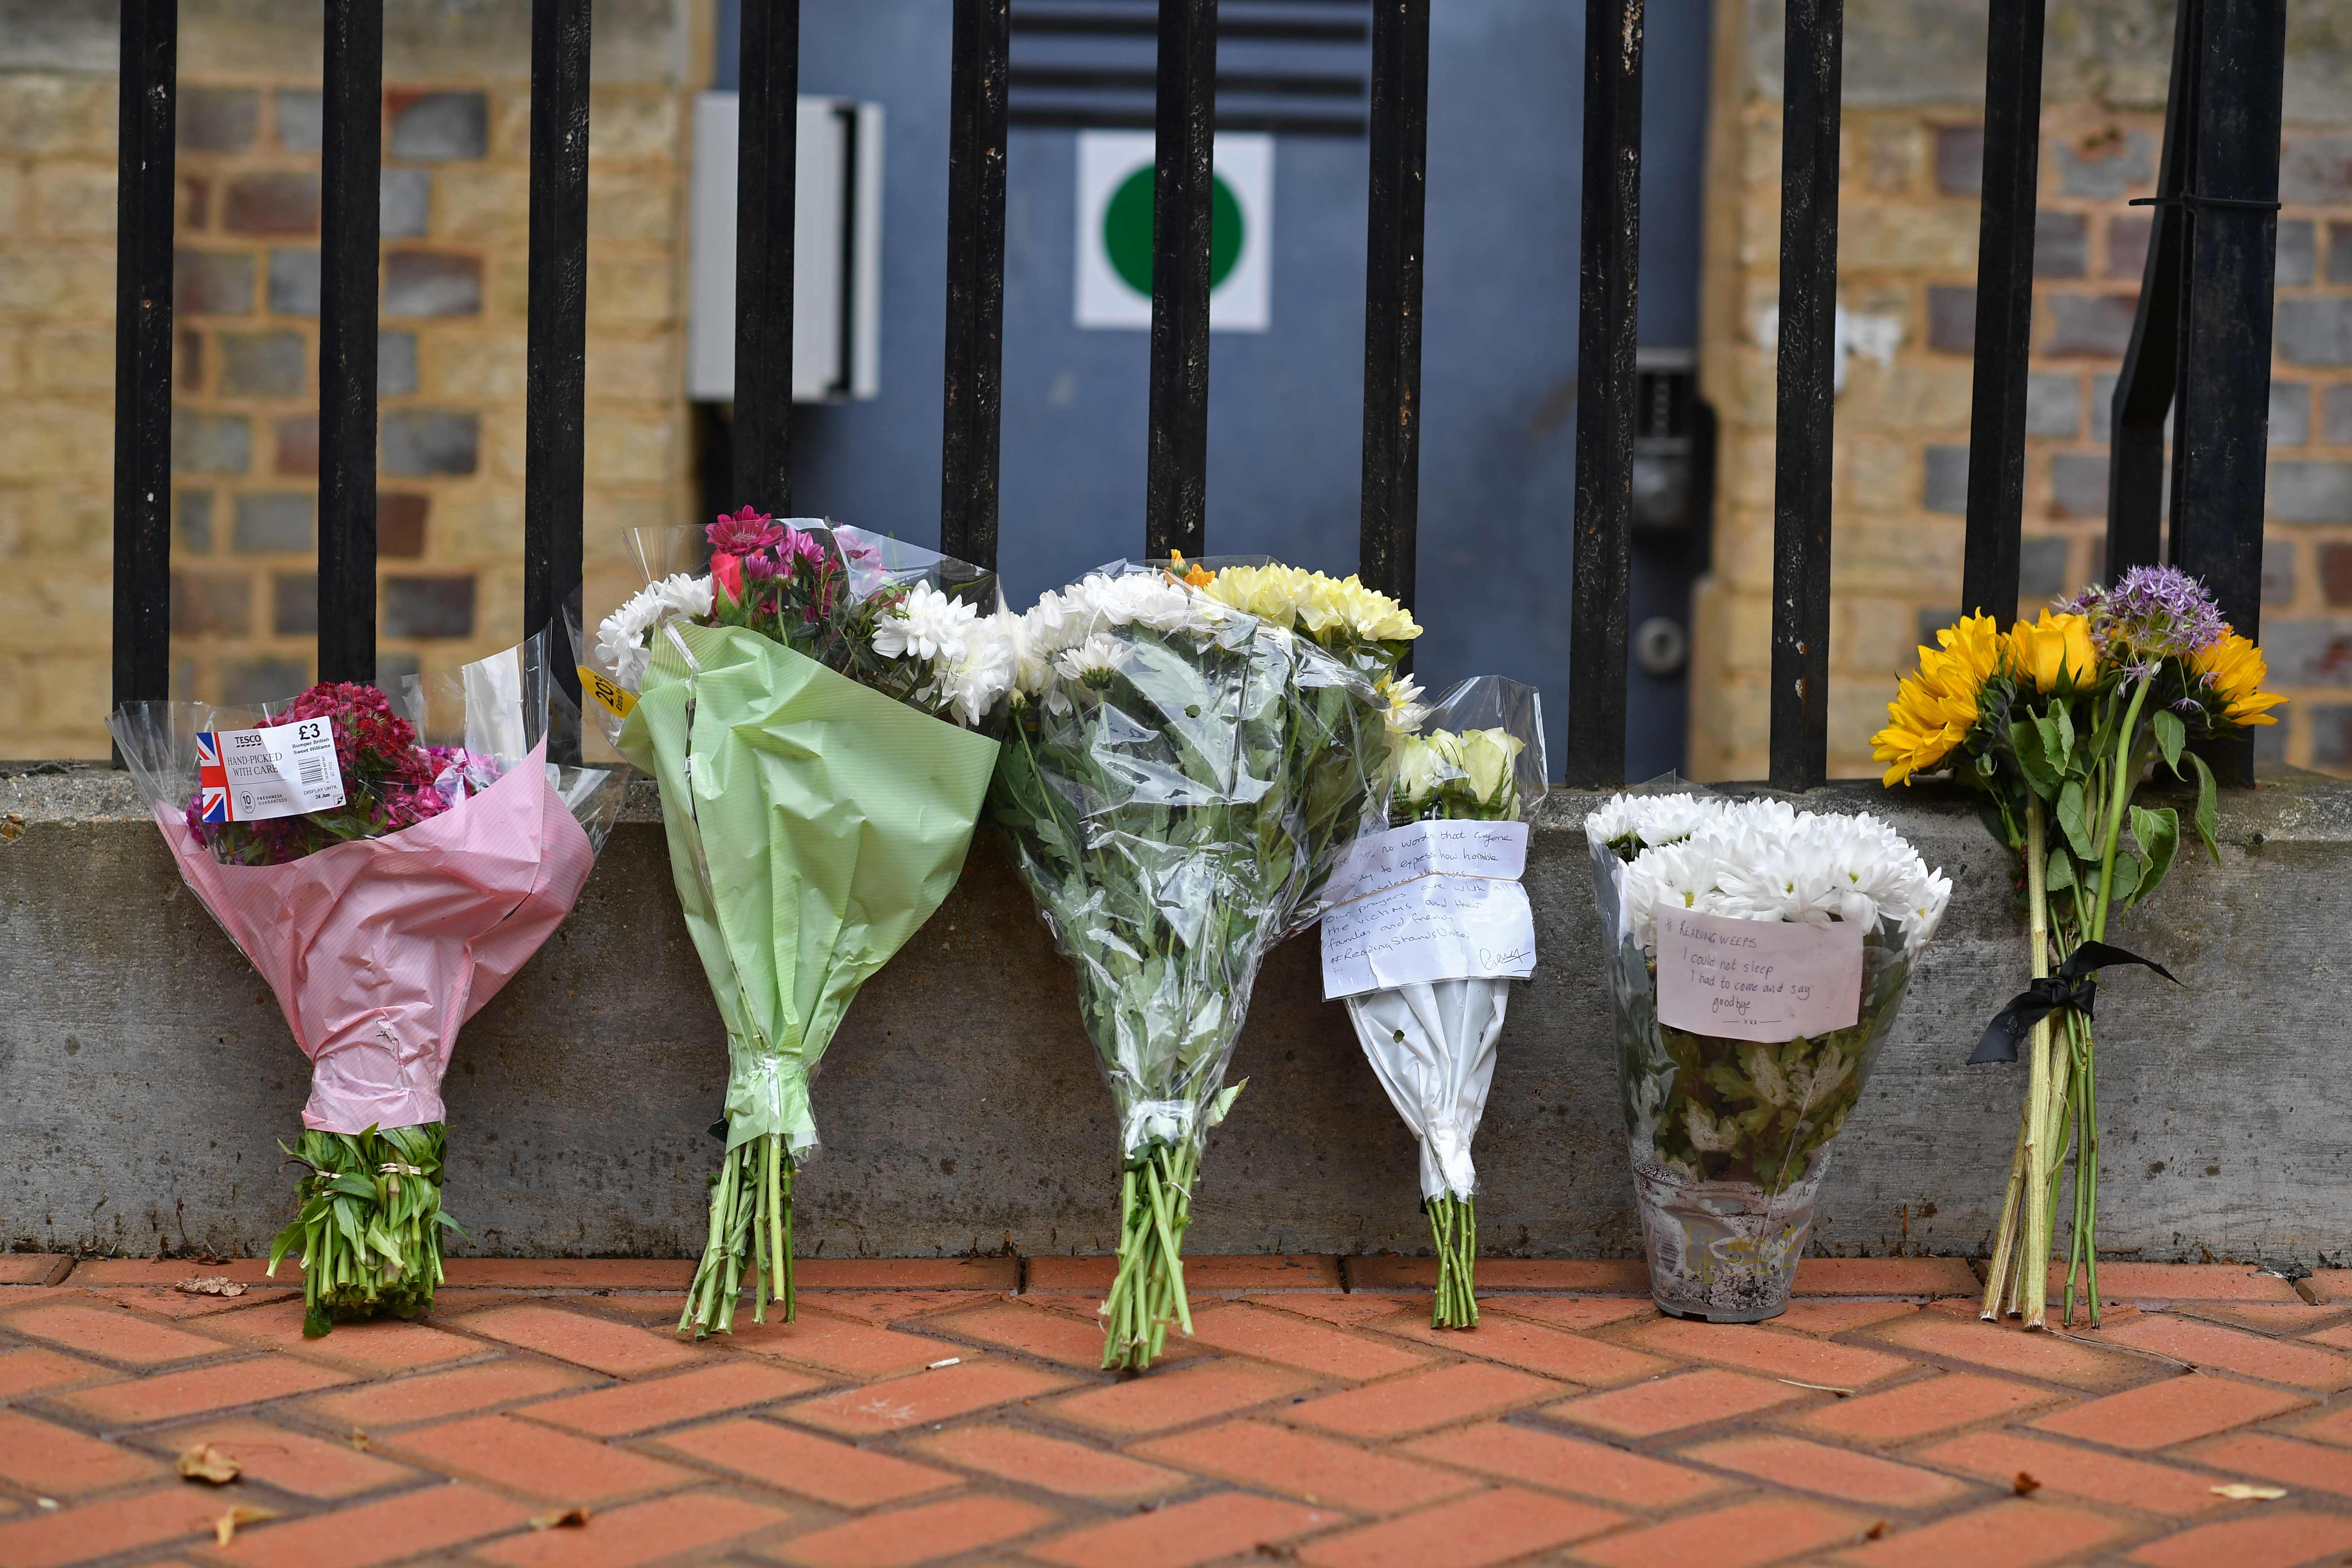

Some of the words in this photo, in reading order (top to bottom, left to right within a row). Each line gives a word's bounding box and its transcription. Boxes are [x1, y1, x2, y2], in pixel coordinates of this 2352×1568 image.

[234, 735, 261, 745] TESCO
[298, 723, 320, 740] £3
[227, 752, 282, 766] HAND-PICKED
[233, 766, 253, 777] WITH
[254, 764, 278, 775] CARE
[242, 795, 251, 805] 10
[258, 798, 287, 806] GUARANTEED
[1382, 846, 1394, 854] no
[1402, 831, 1435, 847] words
[1441, 830, 1466, 840] that
[1474, 831, 1513, 847] anyone
[1381, 865, 1392, 873] to
[1400, 852, 1436, 869] express
[1439, 849, 1457, 860] how
[1463, 848, 1499, 861] horrible
[1358, 893, 1406, 913] prayers
[1454, 882, 1486, 892] with
[1494, 883, 1511, 892] all
[1327, 924, 1349, 936] the
[1425, 898, 1447, 908] and
[1454, 900, 1483, 909] their
[1328, 929, 1371, 951] families
[1380, 917, 1404, 931] and
[1680, 920, 1717, 944] READING
[1720, 936, 1757, 948] WEEPS
[1683, 947, 1687, 960] I
[1690, 953, 1715, 967] could
[1720, 958, 1737, 971] not
[1743, 960, 1774, 980] sleep
[1691, 970, 1695, 982] I
[1699, 972, 1715, 986] had
[1720, 976, 1730, 990] to
[1734, 981, 1758, 992] come
[1763, 982, 1784, 993] and
[1791, 985, 1811, 1001] say
[1712, 995, 1751, 1015] goodbye
